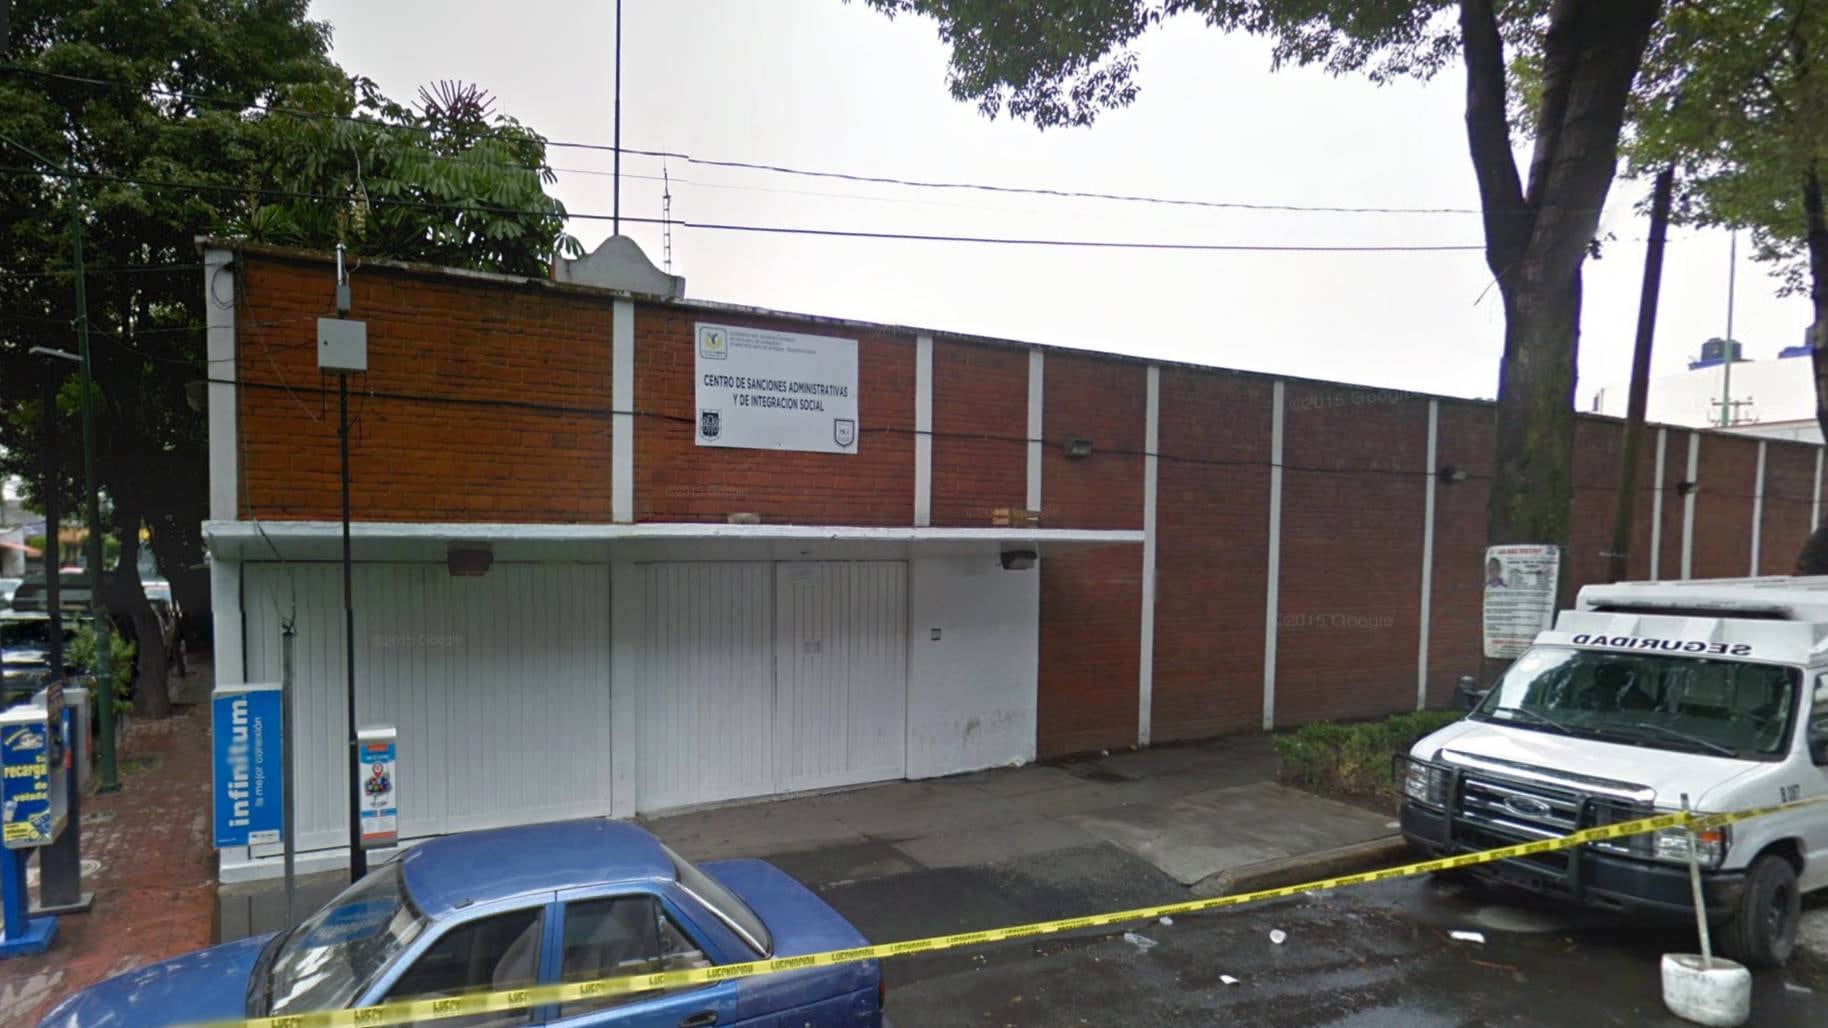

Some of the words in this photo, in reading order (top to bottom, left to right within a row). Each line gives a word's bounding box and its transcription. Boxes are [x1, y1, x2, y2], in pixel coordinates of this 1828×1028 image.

[704, 374, 734, 388] CENTRO
[736, 377, 745, 389] DE
[747, 378, 786, 392] SANCIONES
[788, 382, 848, 397] ADMINISTRATIVAS
[733, 393, 738, 405] Y
[739, 394, 749, 406] DE
[799, 399, 824, 411] SOCIAL
[3, 764, 48, 779] recarga
[255, 766, 265, 797] mejor
